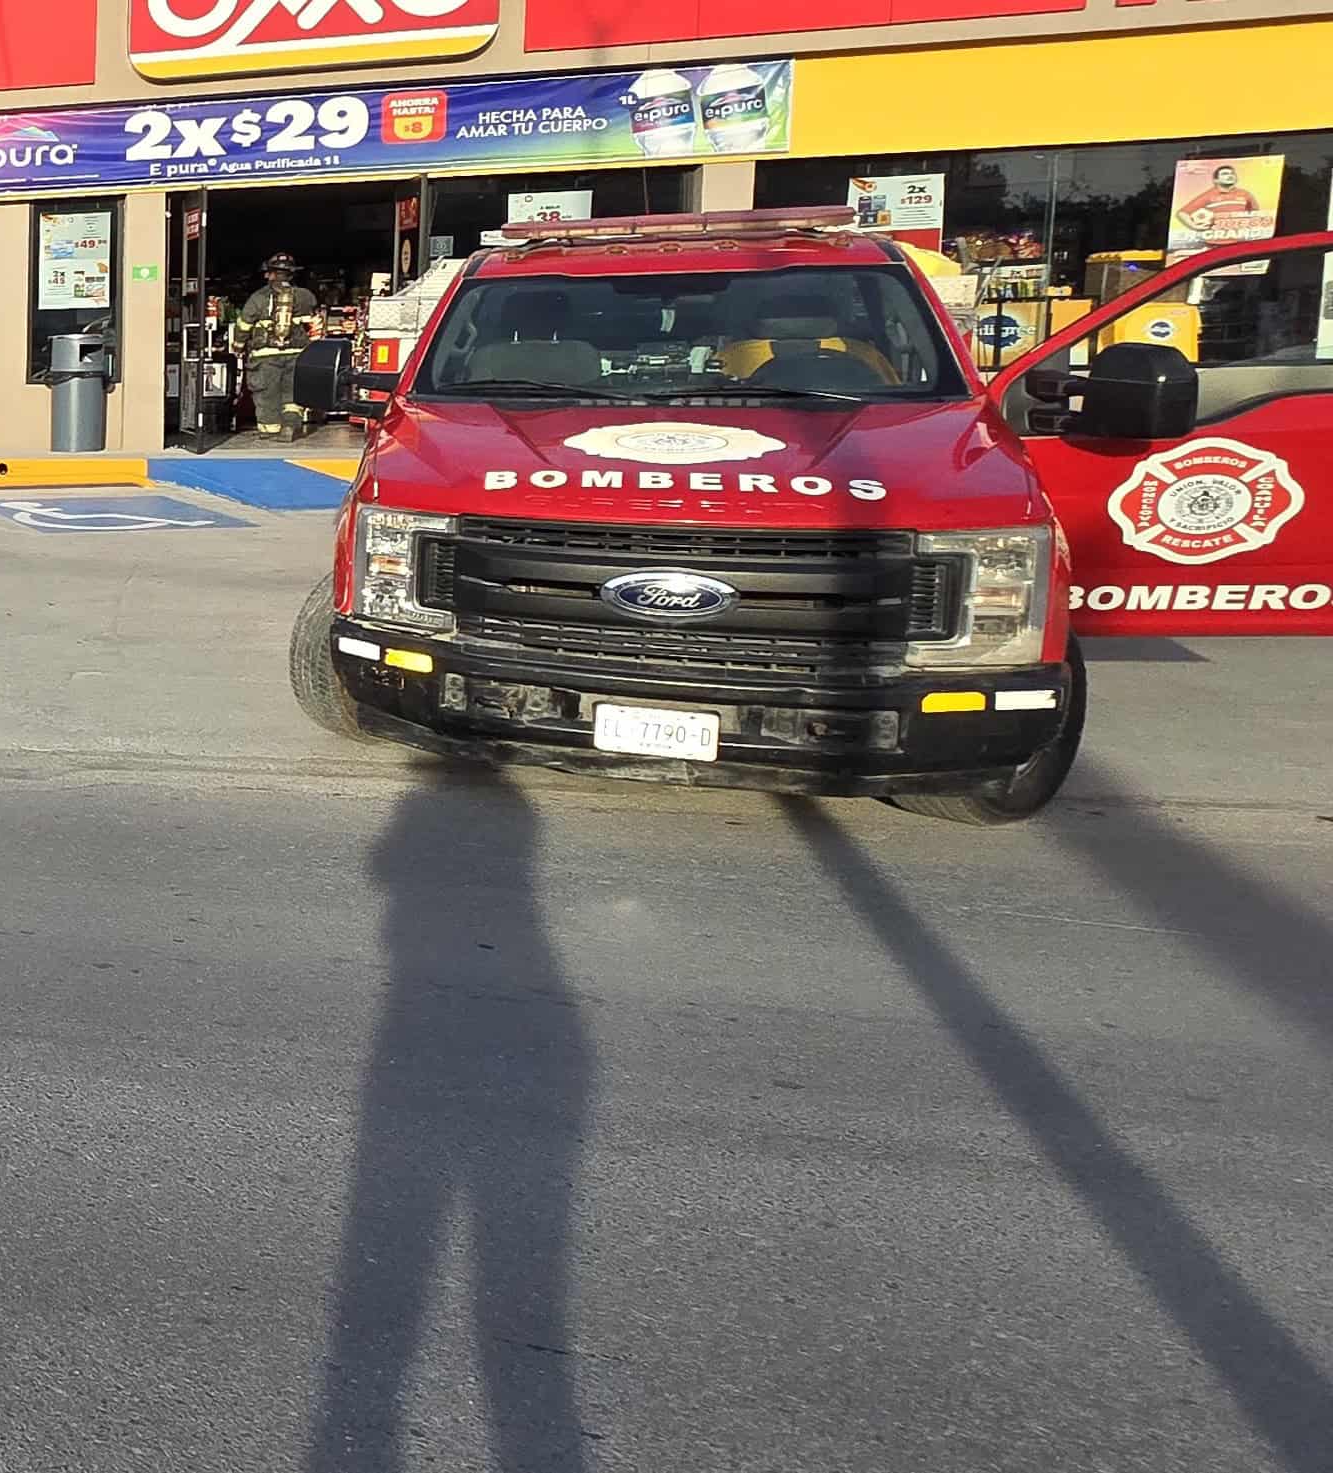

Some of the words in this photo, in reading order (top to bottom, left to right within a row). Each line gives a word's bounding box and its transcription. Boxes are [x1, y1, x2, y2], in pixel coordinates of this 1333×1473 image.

[389, 98, 439, 108] AHORRA
[478, 110, 537, 124] HECHA
[542, 106, 586, 120] PARA
[456, 125, 508, 139] AMAR
[513, 121, 534, 135] TU
[538, 117, 608, 133] CUERPO
[150, 163, 161, 176] E
[219, 161, 251, 172] Agua
[255, 157, 321, 169] Purificada
[907, 185, 927, 194] 2x
[1173, 456, 1248, 470] BOMBEROS
[484, 470, 887, 500] BOMBEROS
[1212, 478, 1243, 495] VALOR
[1175, 517, 1235, 531] SACRIFICIO
[1161, 535, 1234, 549] RESCATE
[637, 584, 702, 608] Ford
[1069, 584, 1333, 610] OMBERO
